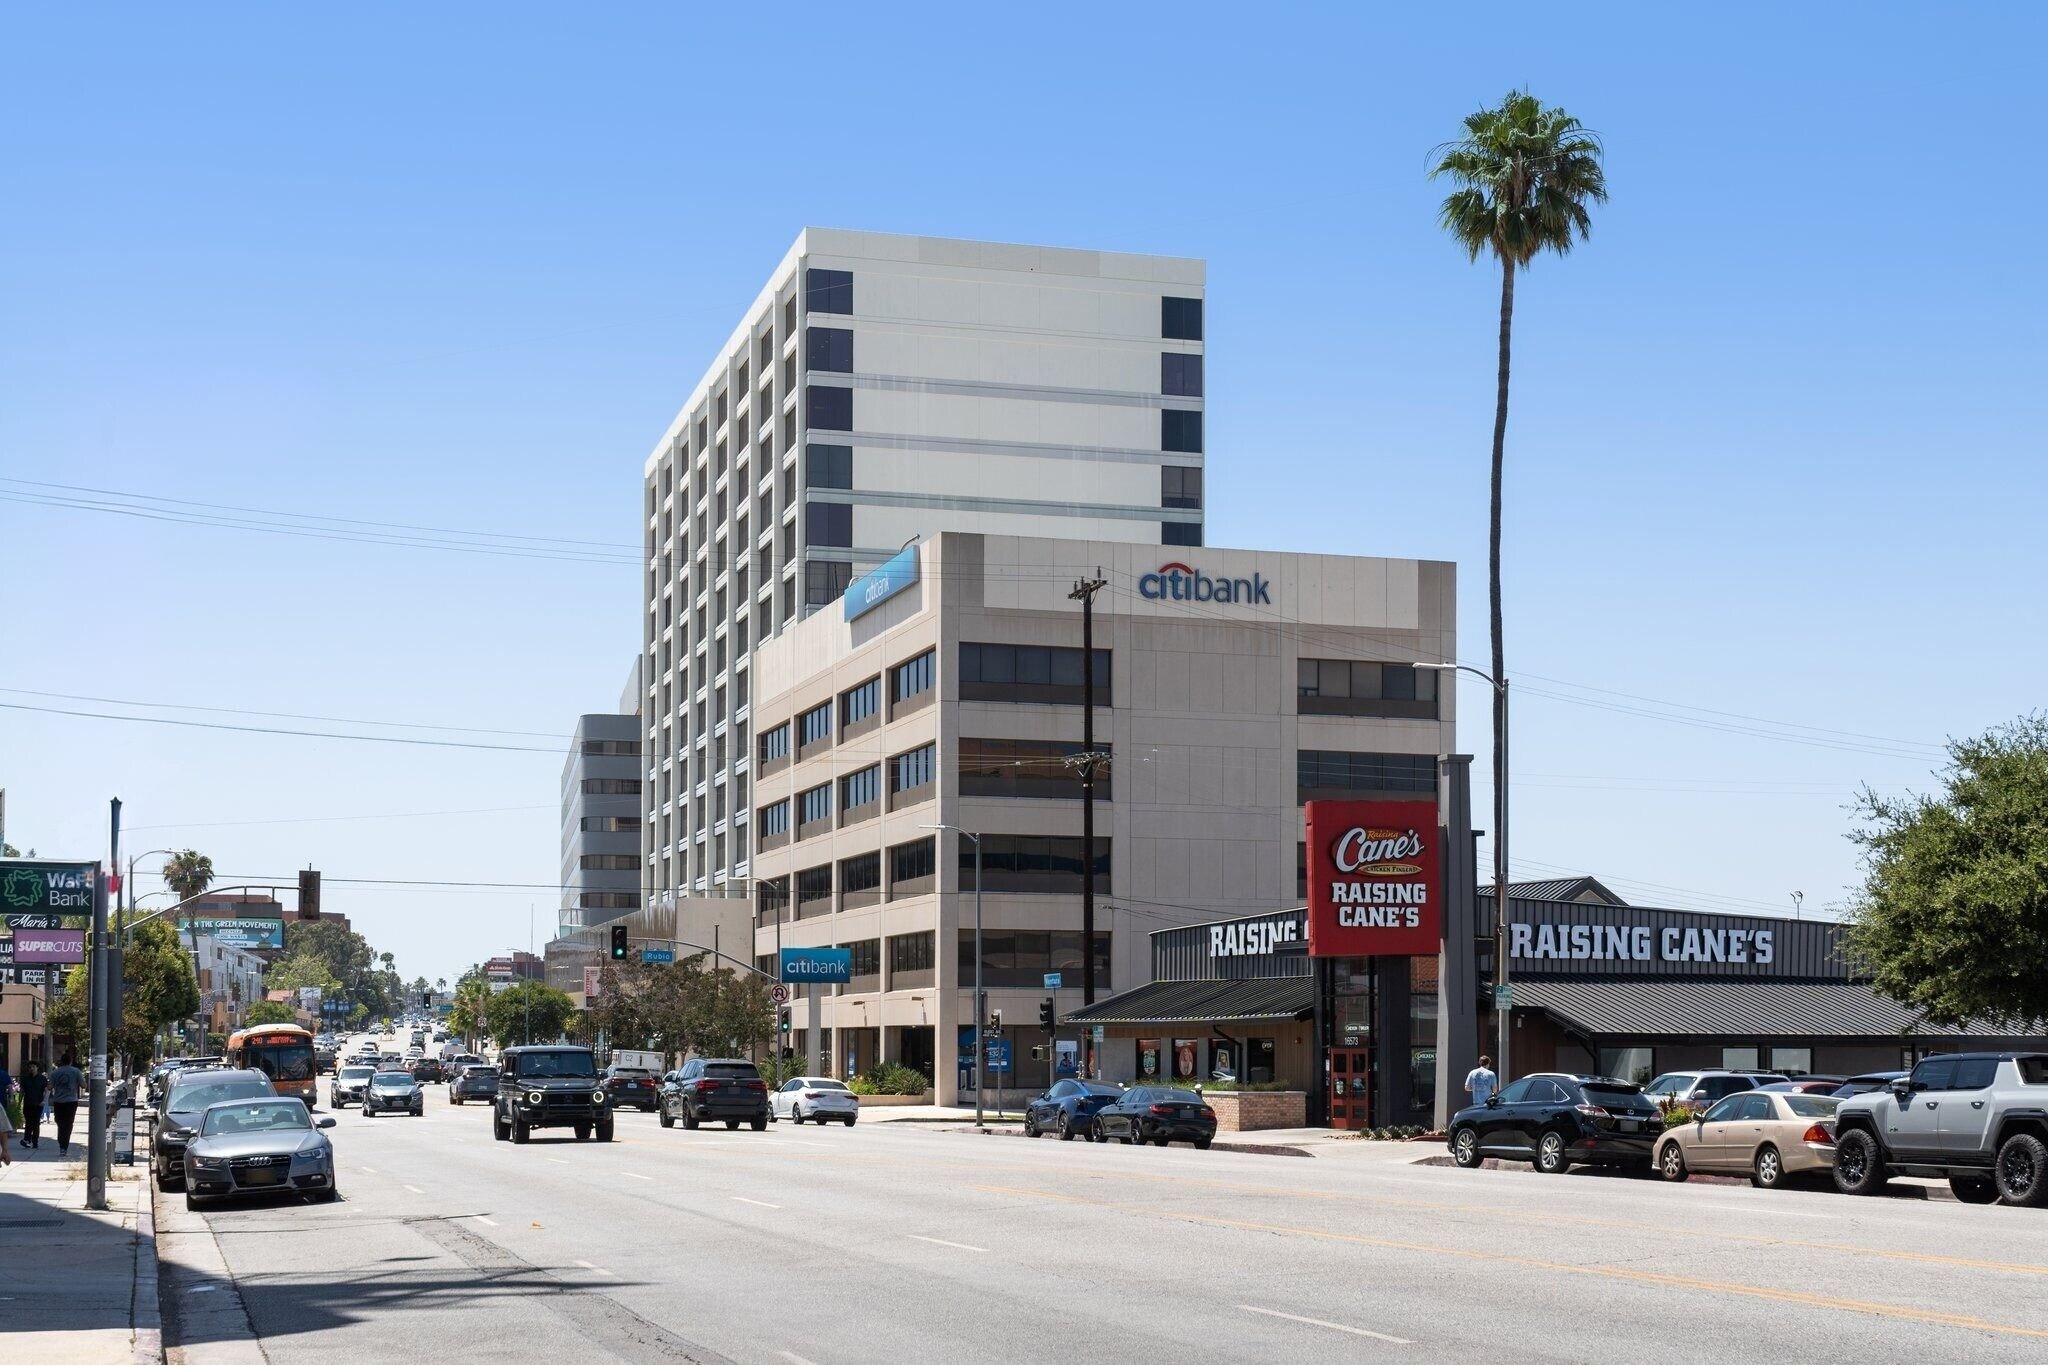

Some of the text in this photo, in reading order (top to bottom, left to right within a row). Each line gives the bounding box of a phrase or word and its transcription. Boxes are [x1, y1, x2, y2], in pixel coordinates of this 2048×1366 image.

[1139, 568, 1271, 604] citibank
[1367, 830, 1399, 840] Raising
[1336, 828, 1424, 872] Cane's
[47, 872, 94, 888] WaF
[50, 890, 90, 906] Bank
[1332, 882, 1426, 903] RAISING
[10, 914, 57, 928] Maria
[1340, 906, 1419, 927] CANE'S
[18, 940, 83, 952] SUPERCUTS
[1210, 920, 1297, 957] RAISING
[1510, 923, 1773, 964] RAISING CANE'S
[786, 959, 846, 974] citibank
[1344, 1037, 1359, 1046] 16573
